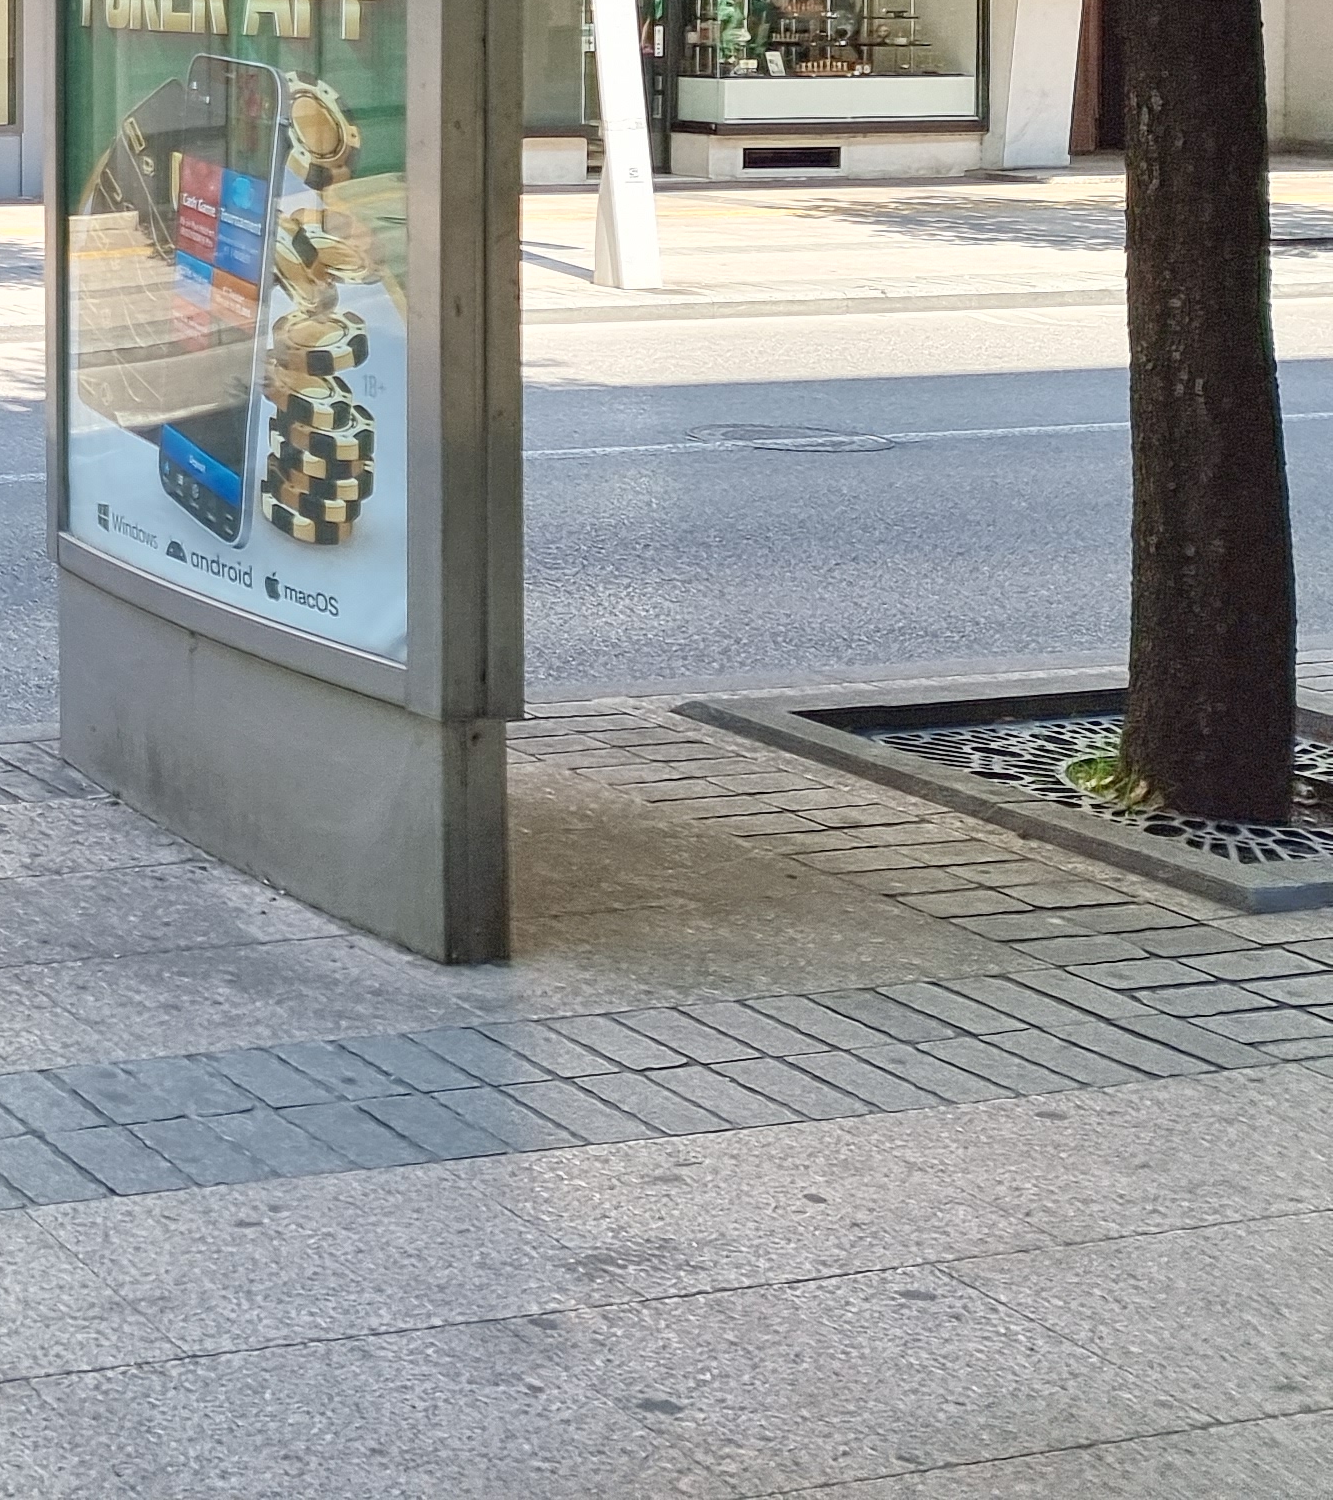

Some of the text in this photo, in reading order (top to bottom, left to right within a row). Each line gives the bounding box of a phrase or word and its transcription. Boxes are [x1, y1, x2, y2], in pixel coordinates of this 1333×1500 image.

[111, 511, 160, 551] Windows
[190, 551, 254, 590] android
[283, 583, 340, 618] macOS
